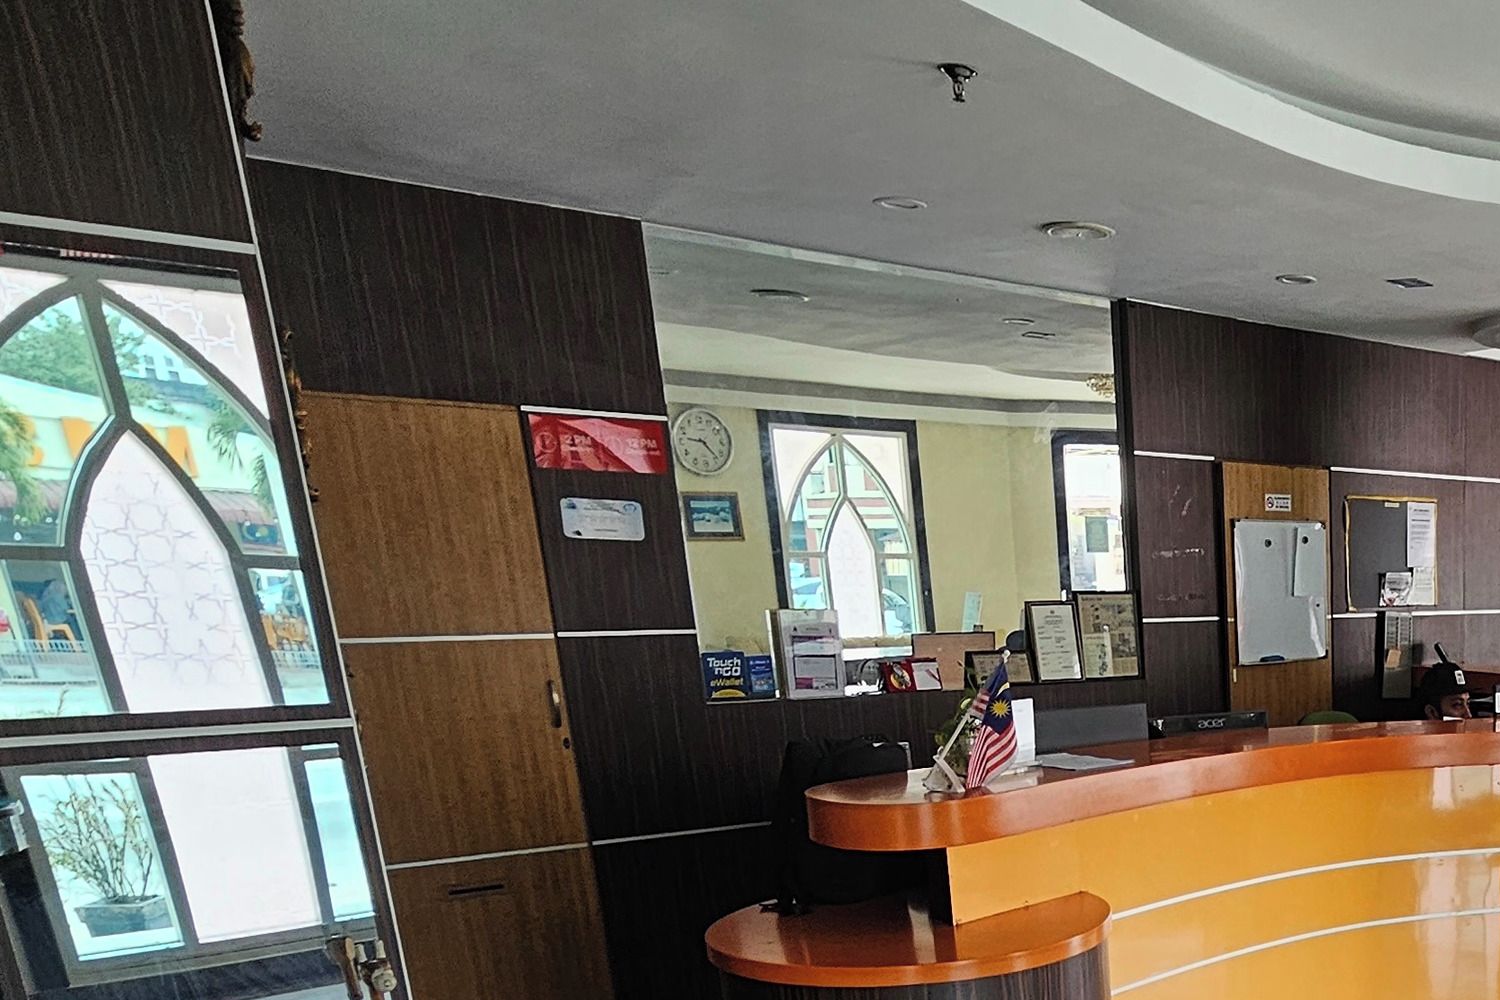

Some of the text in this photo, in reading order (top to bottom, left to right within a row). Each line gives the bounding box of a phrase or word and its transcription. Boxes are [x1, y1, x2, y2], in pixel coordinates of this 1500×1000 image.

[706, 657, 741, 668] Touch
[710, 677, 744, 687] eWallet
[1197, 717, 1227, 729] acer
